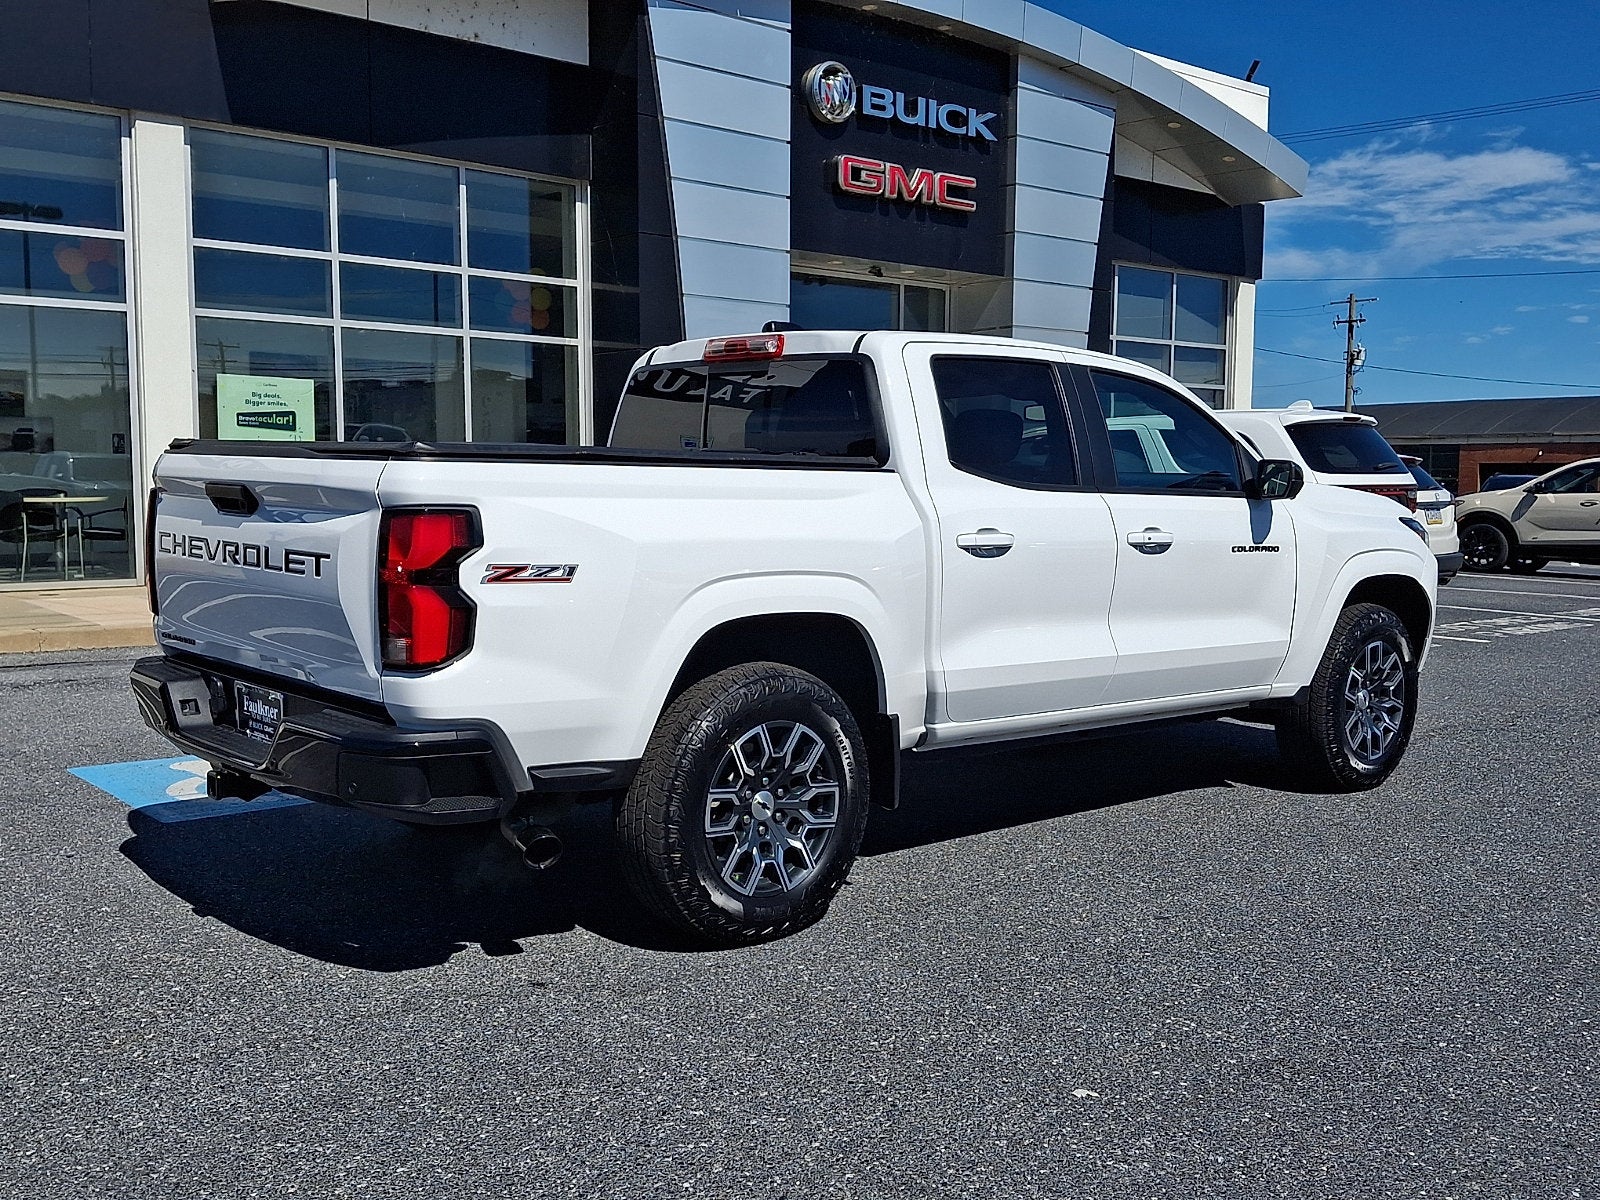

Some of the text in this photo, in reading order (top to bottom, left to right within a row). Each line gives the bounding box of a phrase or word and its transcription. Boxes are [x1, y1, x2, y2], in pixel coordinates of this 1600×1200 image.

[862, 84, 998, 141] BUICK
[838, 154, 977, 212] GMC
[245, 399, 266, 407] Bigger
[238, 413, 293, 426] Bravotacular!
[158, 531, 331, 578] CHEVROLET
[1231, 545, 1280, 553] COLORADO
[480, 563, 579, 584] Z71
[243, 694, 278, 720] Faulkner
[833, 728, 855, 781] TERRITORY
